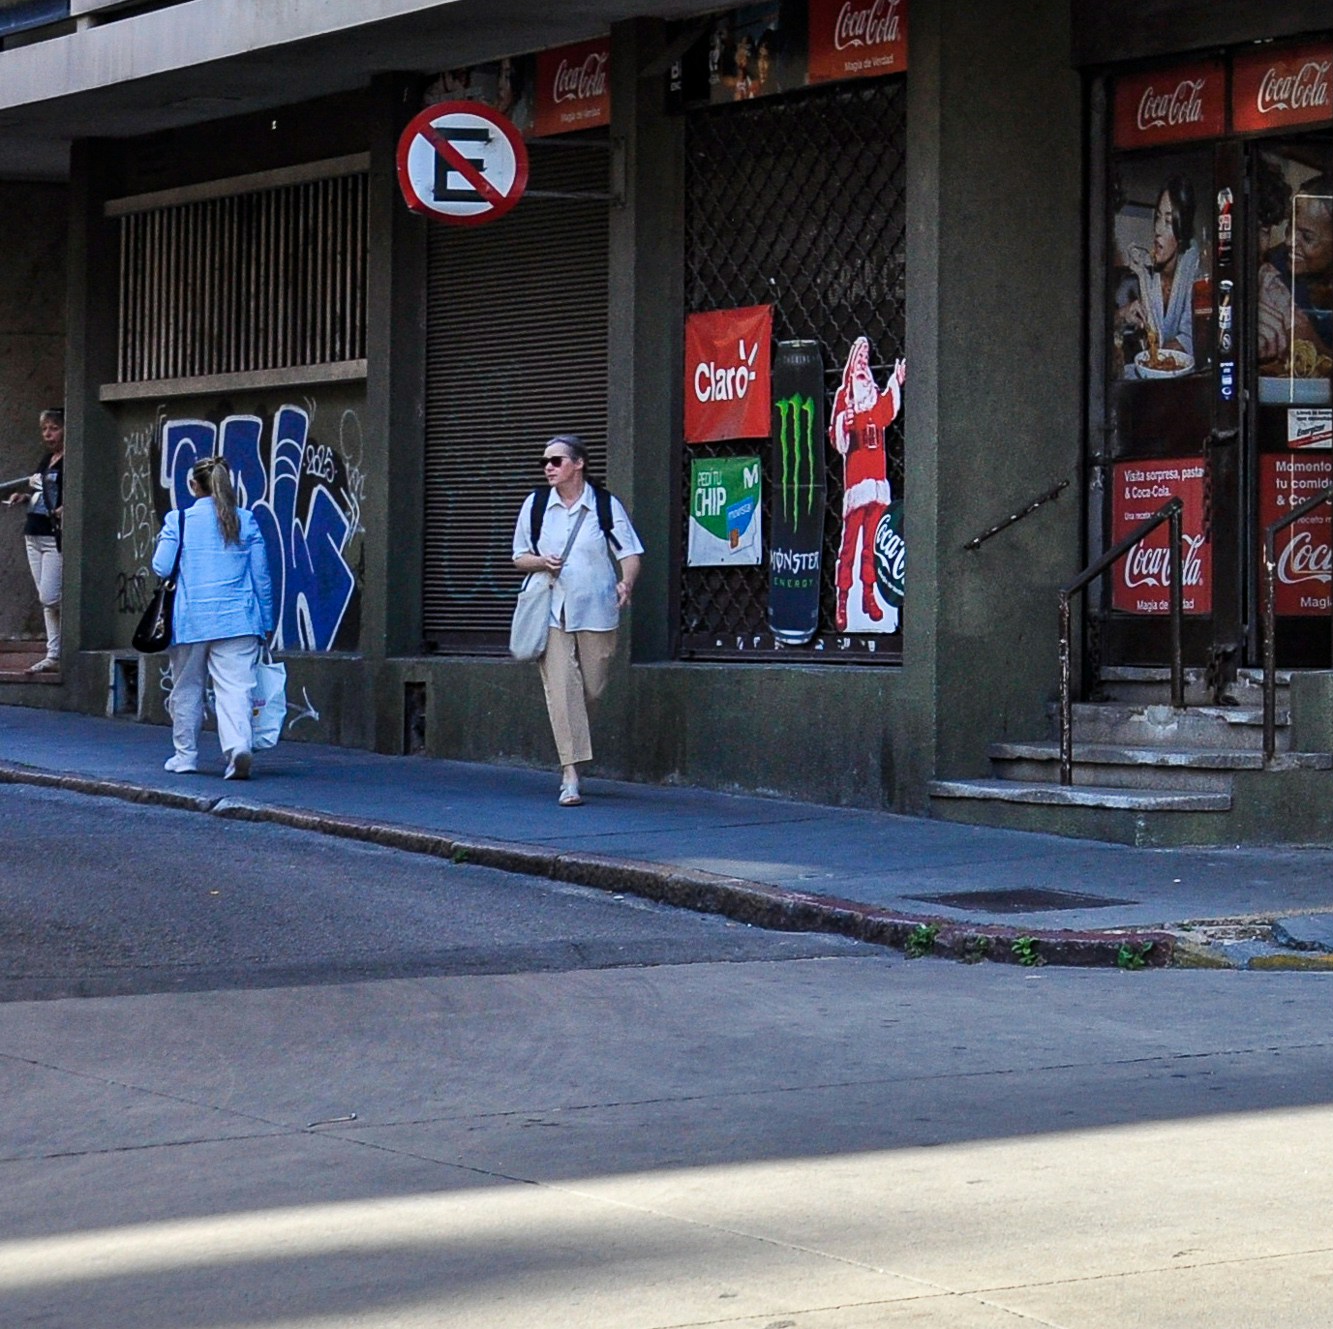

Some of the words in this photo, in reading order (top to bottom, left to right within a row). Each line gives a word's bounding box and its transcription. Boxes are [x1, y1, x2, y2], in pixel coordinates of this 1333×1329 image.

[553, 52, 609, 104] Coca-Cola
[1257, 60, 1331, 113] Coca-Cola
[1137, 78, 1205, 130] Coca-Cola
[695, 362, 749, 403] Claro
[1124, 470, 1144, 482] Visita
[1276, 461, 1332, 472] Momento
[1276, 479, 1288, 489] tu
[695, 487, 727, 517] CHIP
[773, 576, 814, 587] ENERGY
[1137, 599, 1157, 612] Magia
[1159, 599, 1168, 609] de
